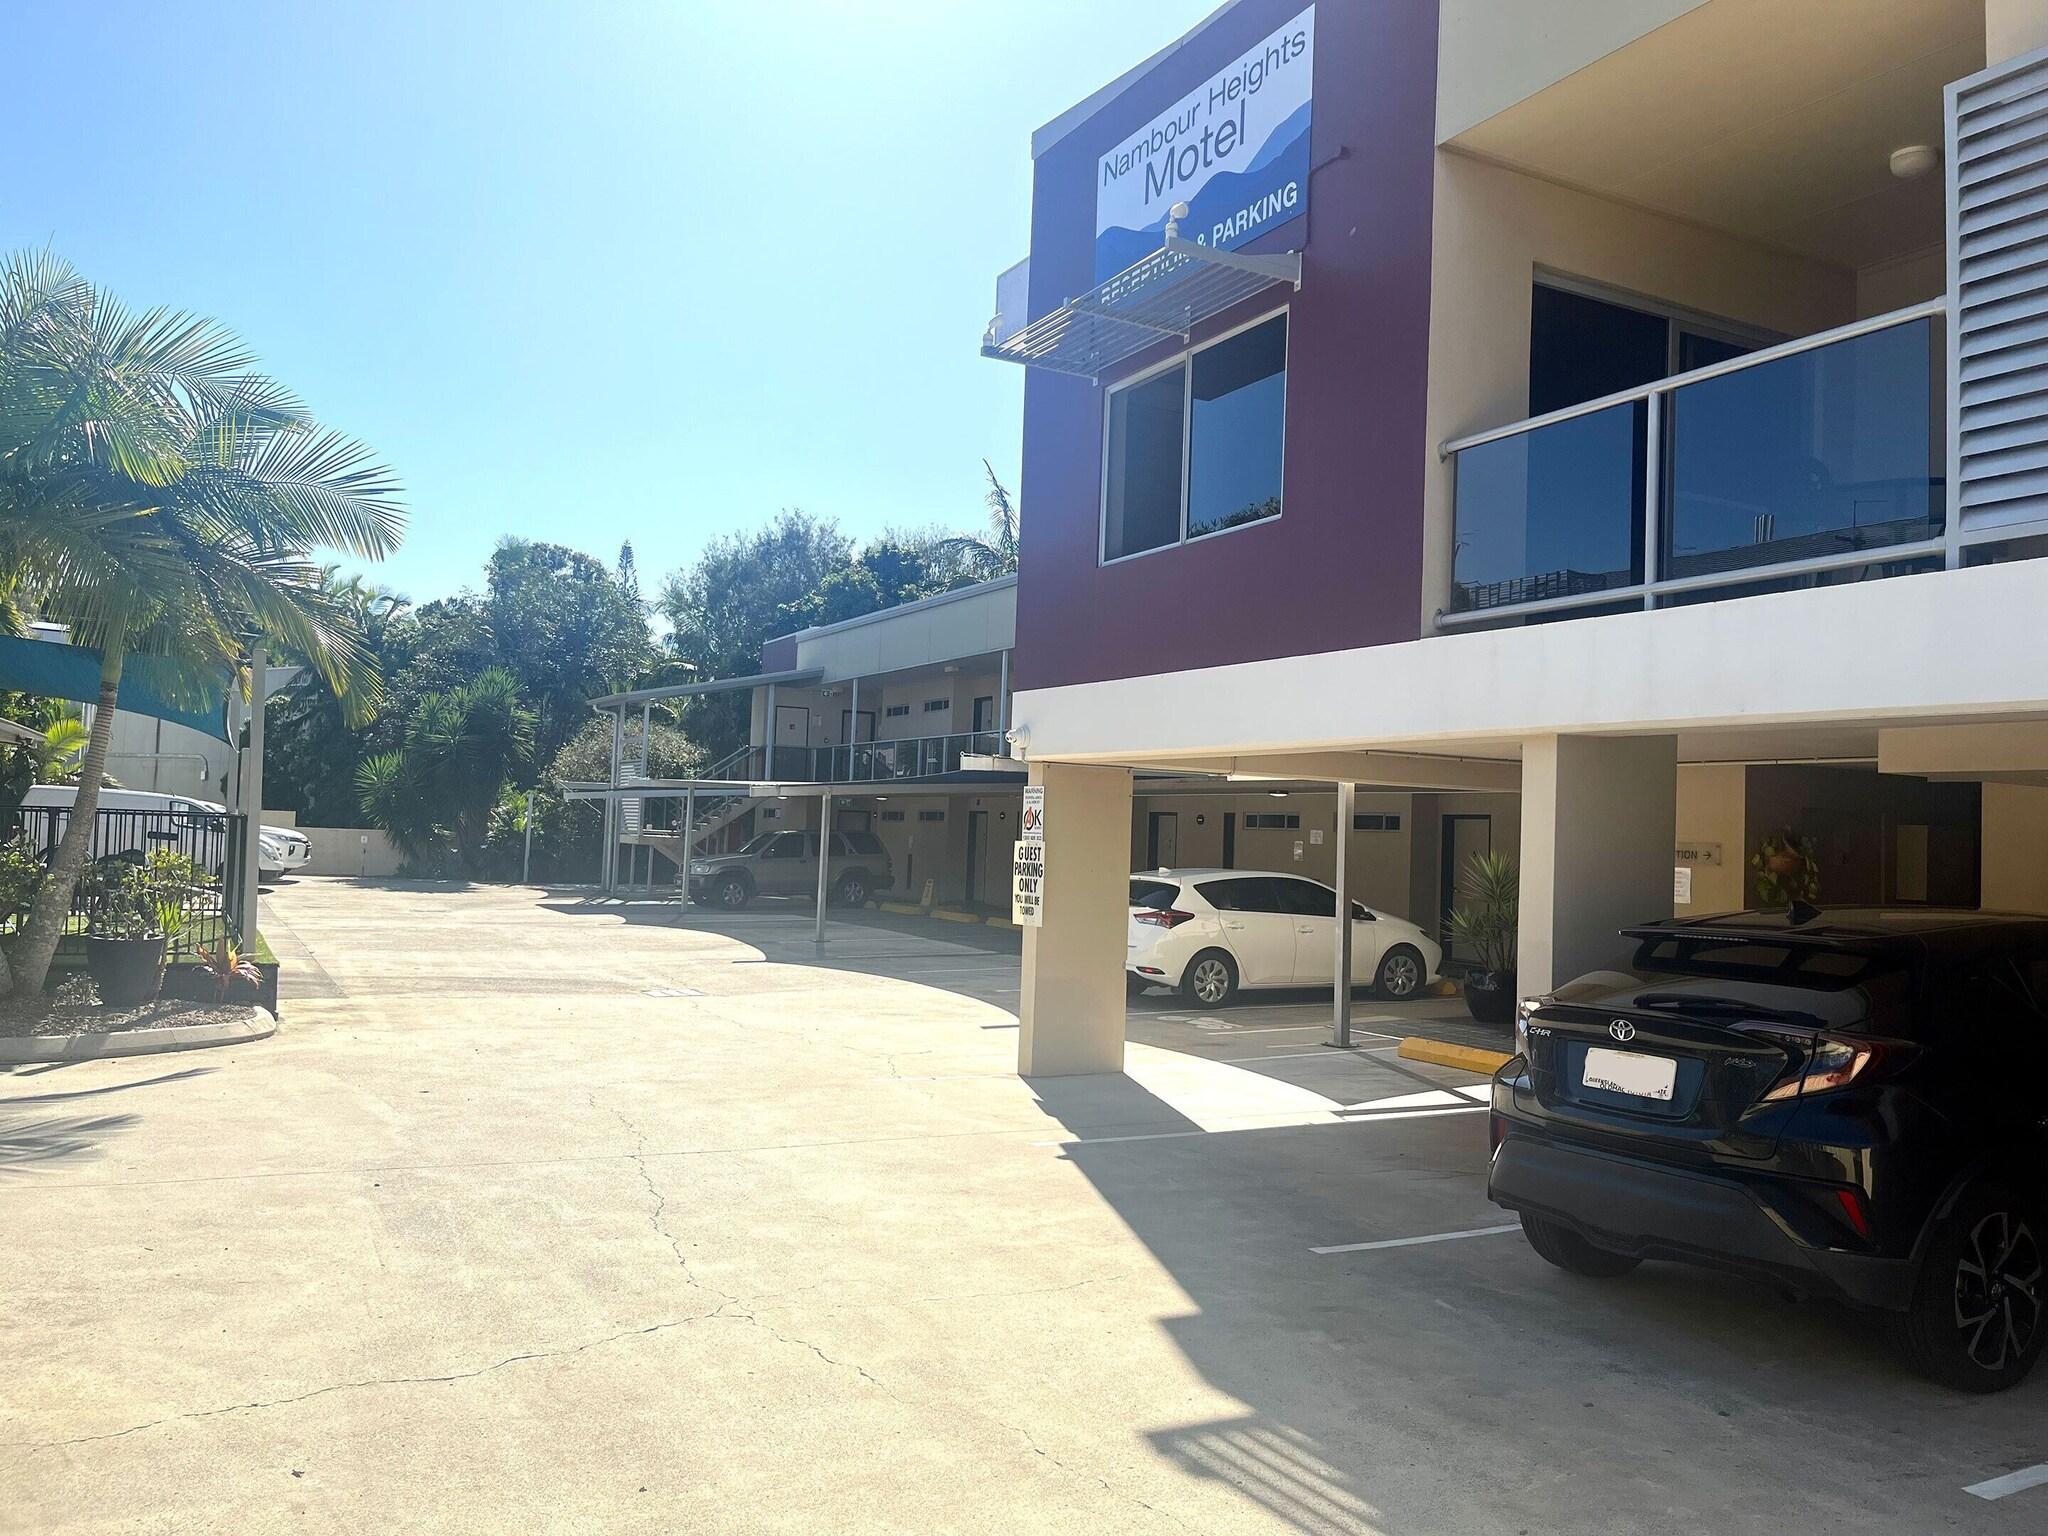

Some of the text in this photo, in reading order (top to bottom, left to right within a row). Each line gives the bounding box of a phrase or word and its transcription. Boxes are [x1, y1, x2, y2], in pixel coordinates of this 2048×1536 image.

[1103, 30, 1306, 187] Nambour Heights
[1144, 98, 1246, 205] Motel
[1212, 181, 1297, 248] PARKING
[1018, 846, 1041, 862] GUEST
[1014, 861, 1043, 878] PARKING
[1018, 878, 1038, 893] ONLY
[1014, 893, 1040, 906] YOU WILL BE
[1019, 905, 1034, 916] TOWED
